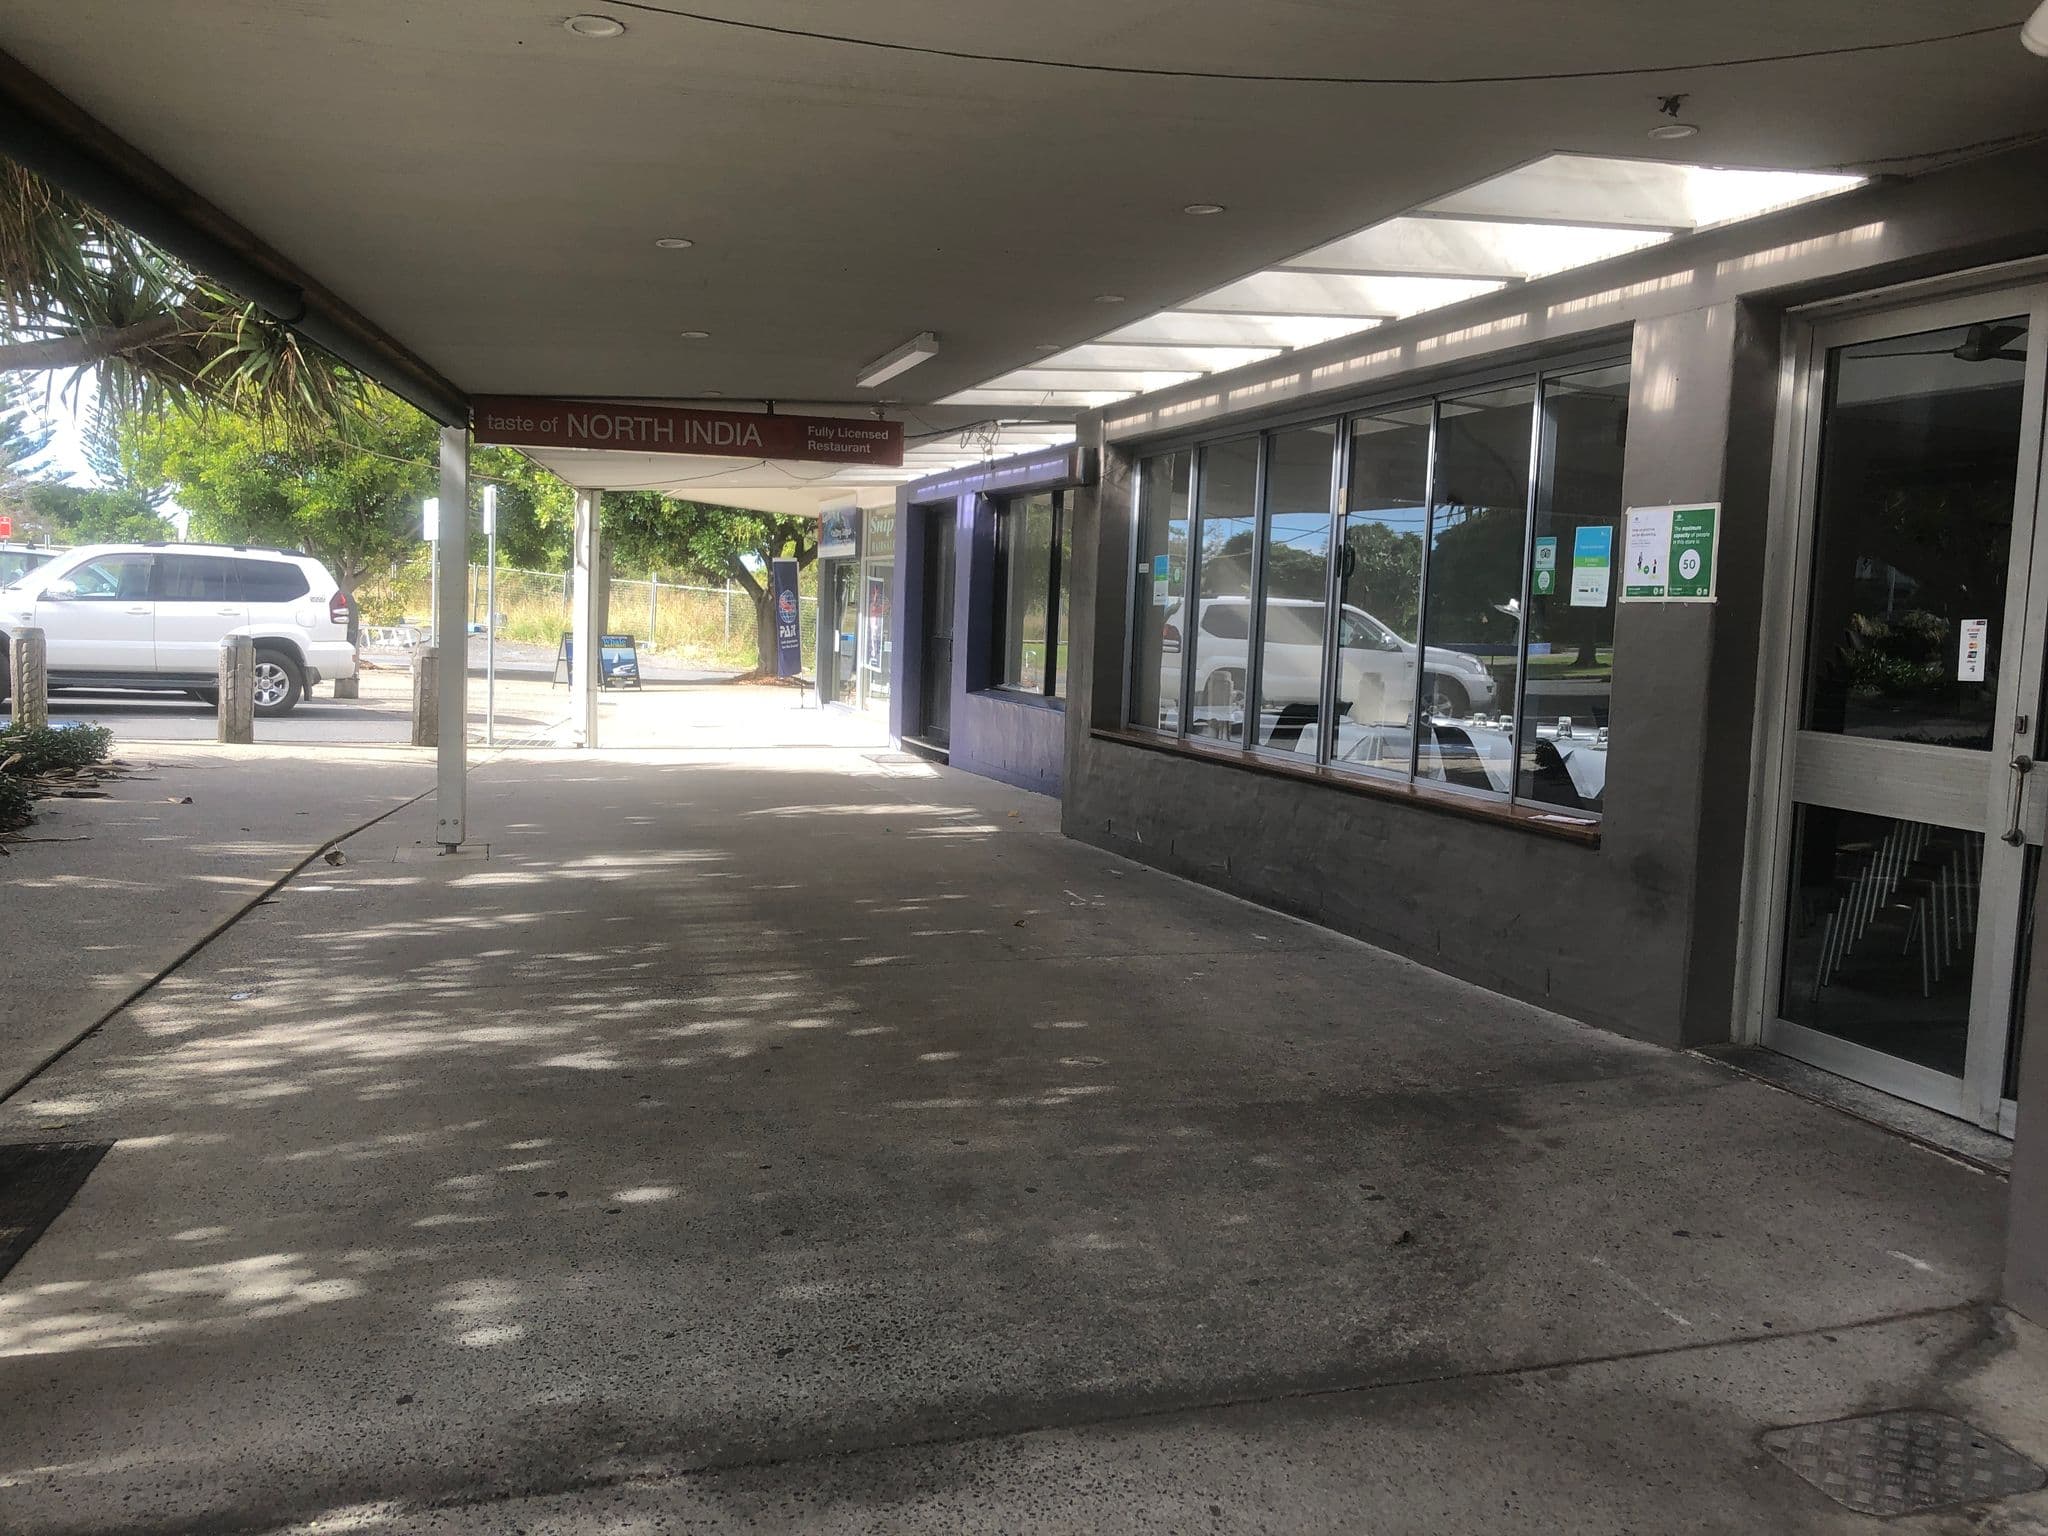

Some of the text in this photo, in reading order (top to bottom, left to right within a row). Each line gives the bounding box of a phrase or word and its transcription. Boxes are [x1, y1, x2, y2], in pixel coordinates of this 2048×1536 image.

[488, 413, 763, 447] taste of NORTH INDIA
[808, 426, 889, 441] Fully Licensed
[808, 440, 871, 454] Restaurant
[1683, 559, 1696, 569] 50
